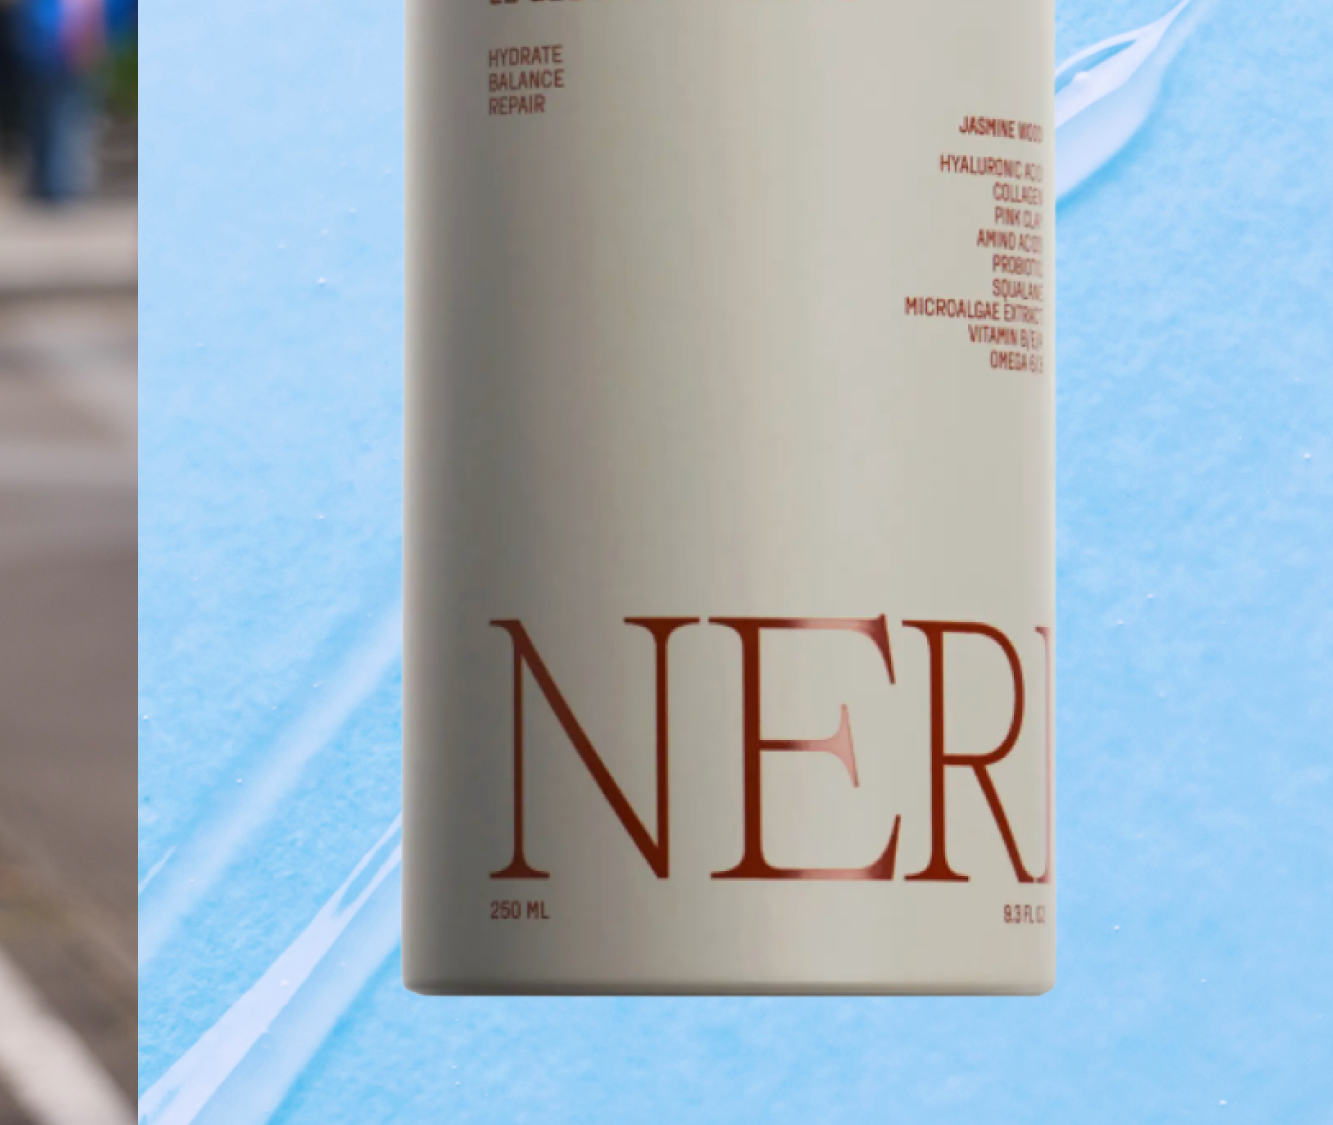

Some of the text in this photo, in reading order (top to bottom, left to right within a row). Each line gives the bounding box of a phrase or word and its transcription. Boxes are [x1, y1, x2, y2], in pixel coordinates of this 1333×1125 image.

[488, 45, 563, 68] HYDRATE
[488, 69, 565, 91] BALANCE
[488, 95, 545, 115] REPAIR
[959, 116, 1015, 138] JASMINE
[939, 154, 1021, 179] HYALURONIC
[995, 206, 1021, 226] PINK
[977, 229, 1015, 250] AMINO
[904, 296, 1000, 321] MICROALGAE
[968, 323, 1017, 346] VITAMIN
[990, 350, 1027, 371] OMEGA
[490, 901, 550, 920] 250 ML
